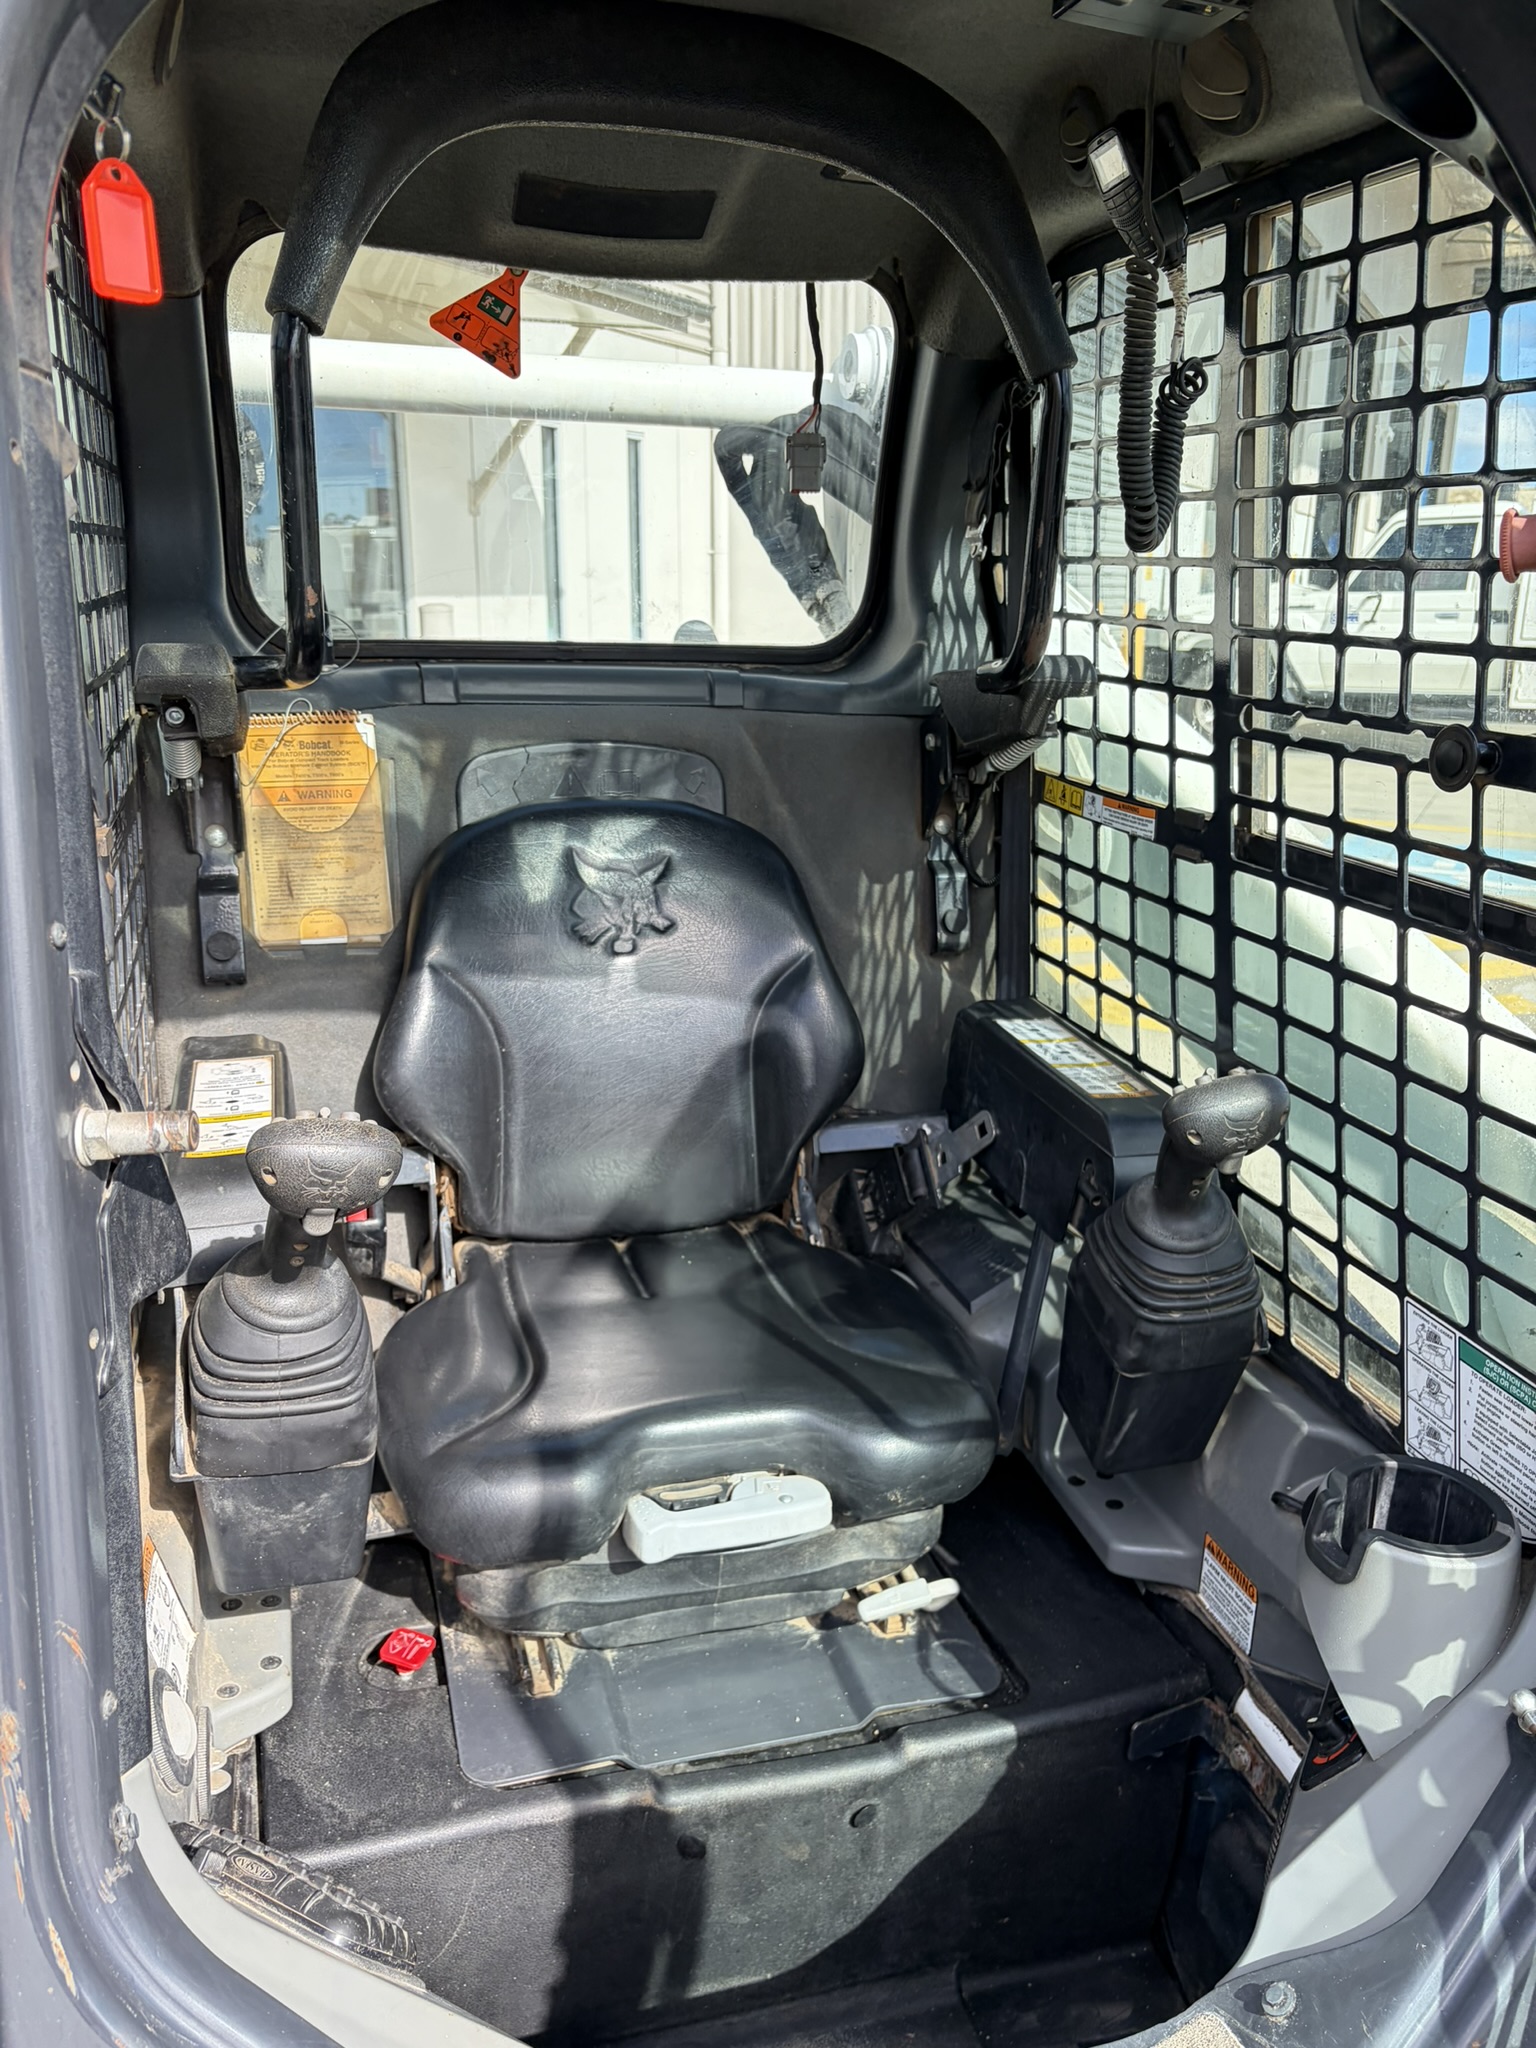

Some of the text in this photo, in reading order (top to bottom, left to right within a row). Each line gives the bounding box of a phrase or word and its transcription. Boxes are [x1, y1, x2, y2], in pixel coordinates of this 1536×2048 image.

[296, 789, 352, 800] WARNING
[1122, 804, 1140, 814] WARNING
[1471, 1370, 1526, 1413] TO OPERATE LOADER:
[1483, 1366, 1498, 1382] (SJC)
[1499, 1378, 1508, 1388] OR
[1509, 1385, 1530, 1405] (SCPA)
[1485, 1359, 1520, 1388] OPERATION
[1476, 1399, 1486, 1409] start
[1478, 1385, 1492, 1398] Fasten
[1493, 1396, 1502, 1405] seat
[1503, 1403, 1511, 1412] belt
[1521, 1416, 1533, 1427] lower
[1485, 1399, 1503, 1416] joysticks
[1510, 1418, 1527, 1434] steering
[1473, 1418, 1495, 1437] instrument
[1474, 1413, 1487, 1424] Select
[1488, 1423, 1502, 1436] control
[1503, 1434, 1515, 1445] mode
[1516, 1443, 1525, 1454] (ISO
[1479, 1410, 1498, 1428] equipped
[1499, 1424, 1507, 1433] with
[1509, 1431, 1530, 1450] Selectable
[1471, 1432, 1484, 1444] button
[1499, 1454, 1521, 1473] instrument
[1472, 1426, 1489, 1442] Activate
[1489, 1439, 1502, 1451] Green
[1503, 1449, 1520, 1465] "PRESS
[1521, 1462, 1527, 1471] TO
[1481, 1450, 1497, 1466] Activate
[1498, 1464, 1514, 1480] "PRESS
[1516, 1476, 1522, 1486] TO
[1479, 1465, 1496, 1480] lowered
[1514, 1493, 1529, 1506] turned
[1480, 1458, 1494, 1471] button
[1495, 1469, 1506, 1481] again
[1511, 1482, 1520, 1491] seat
[1216, 1546, 1255, 1598] WARNING
